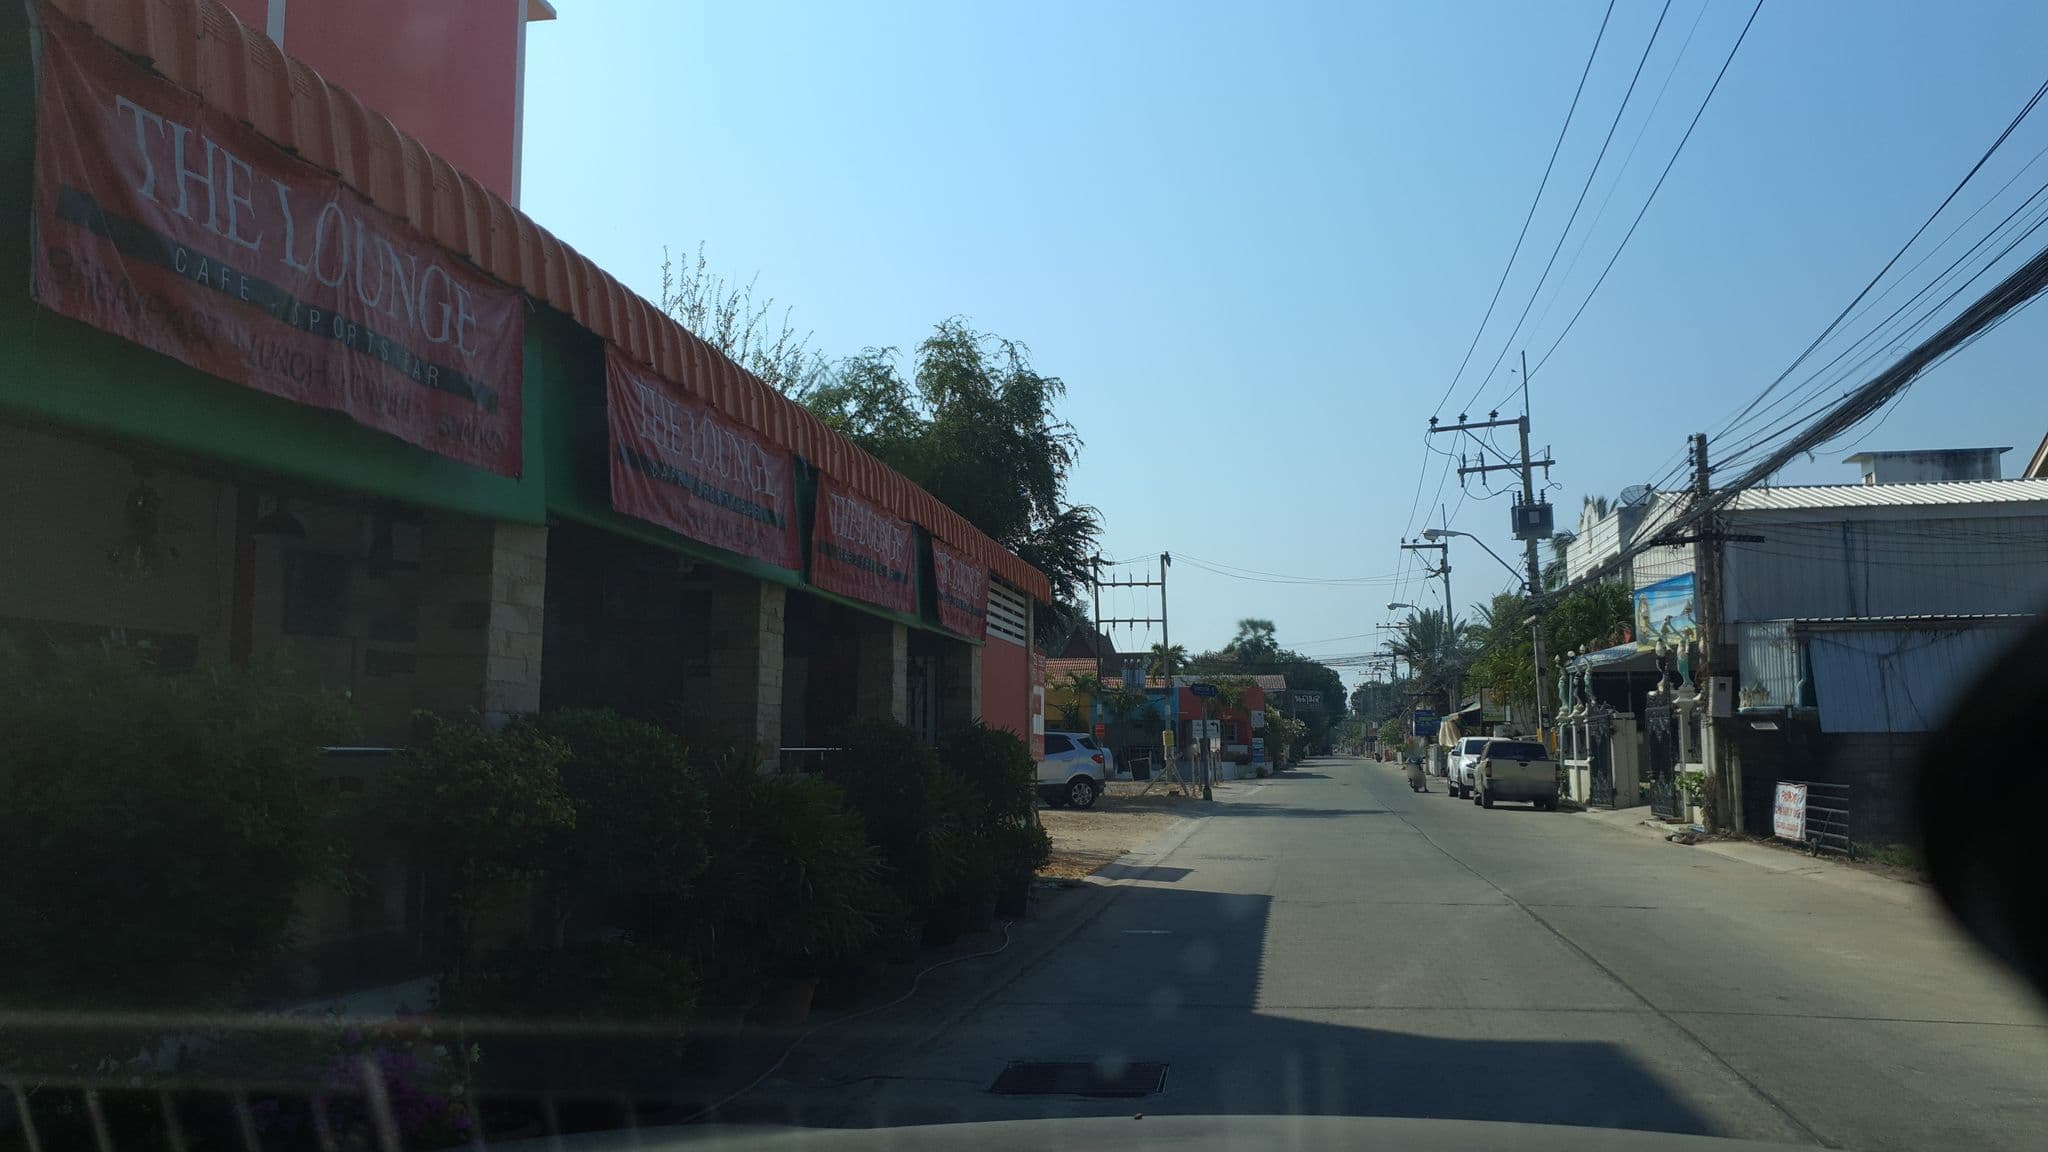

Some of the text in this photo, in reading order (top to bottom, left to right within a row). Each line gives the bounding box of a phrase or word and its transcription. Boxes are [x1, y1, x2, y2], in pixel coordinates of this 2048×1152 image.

[114, 94, 263, 250] THE
[272, 178, 479, 358] LOUNGE
[174, 247, 250, 303] CAFE
[632, 378, 681, 456] THE
